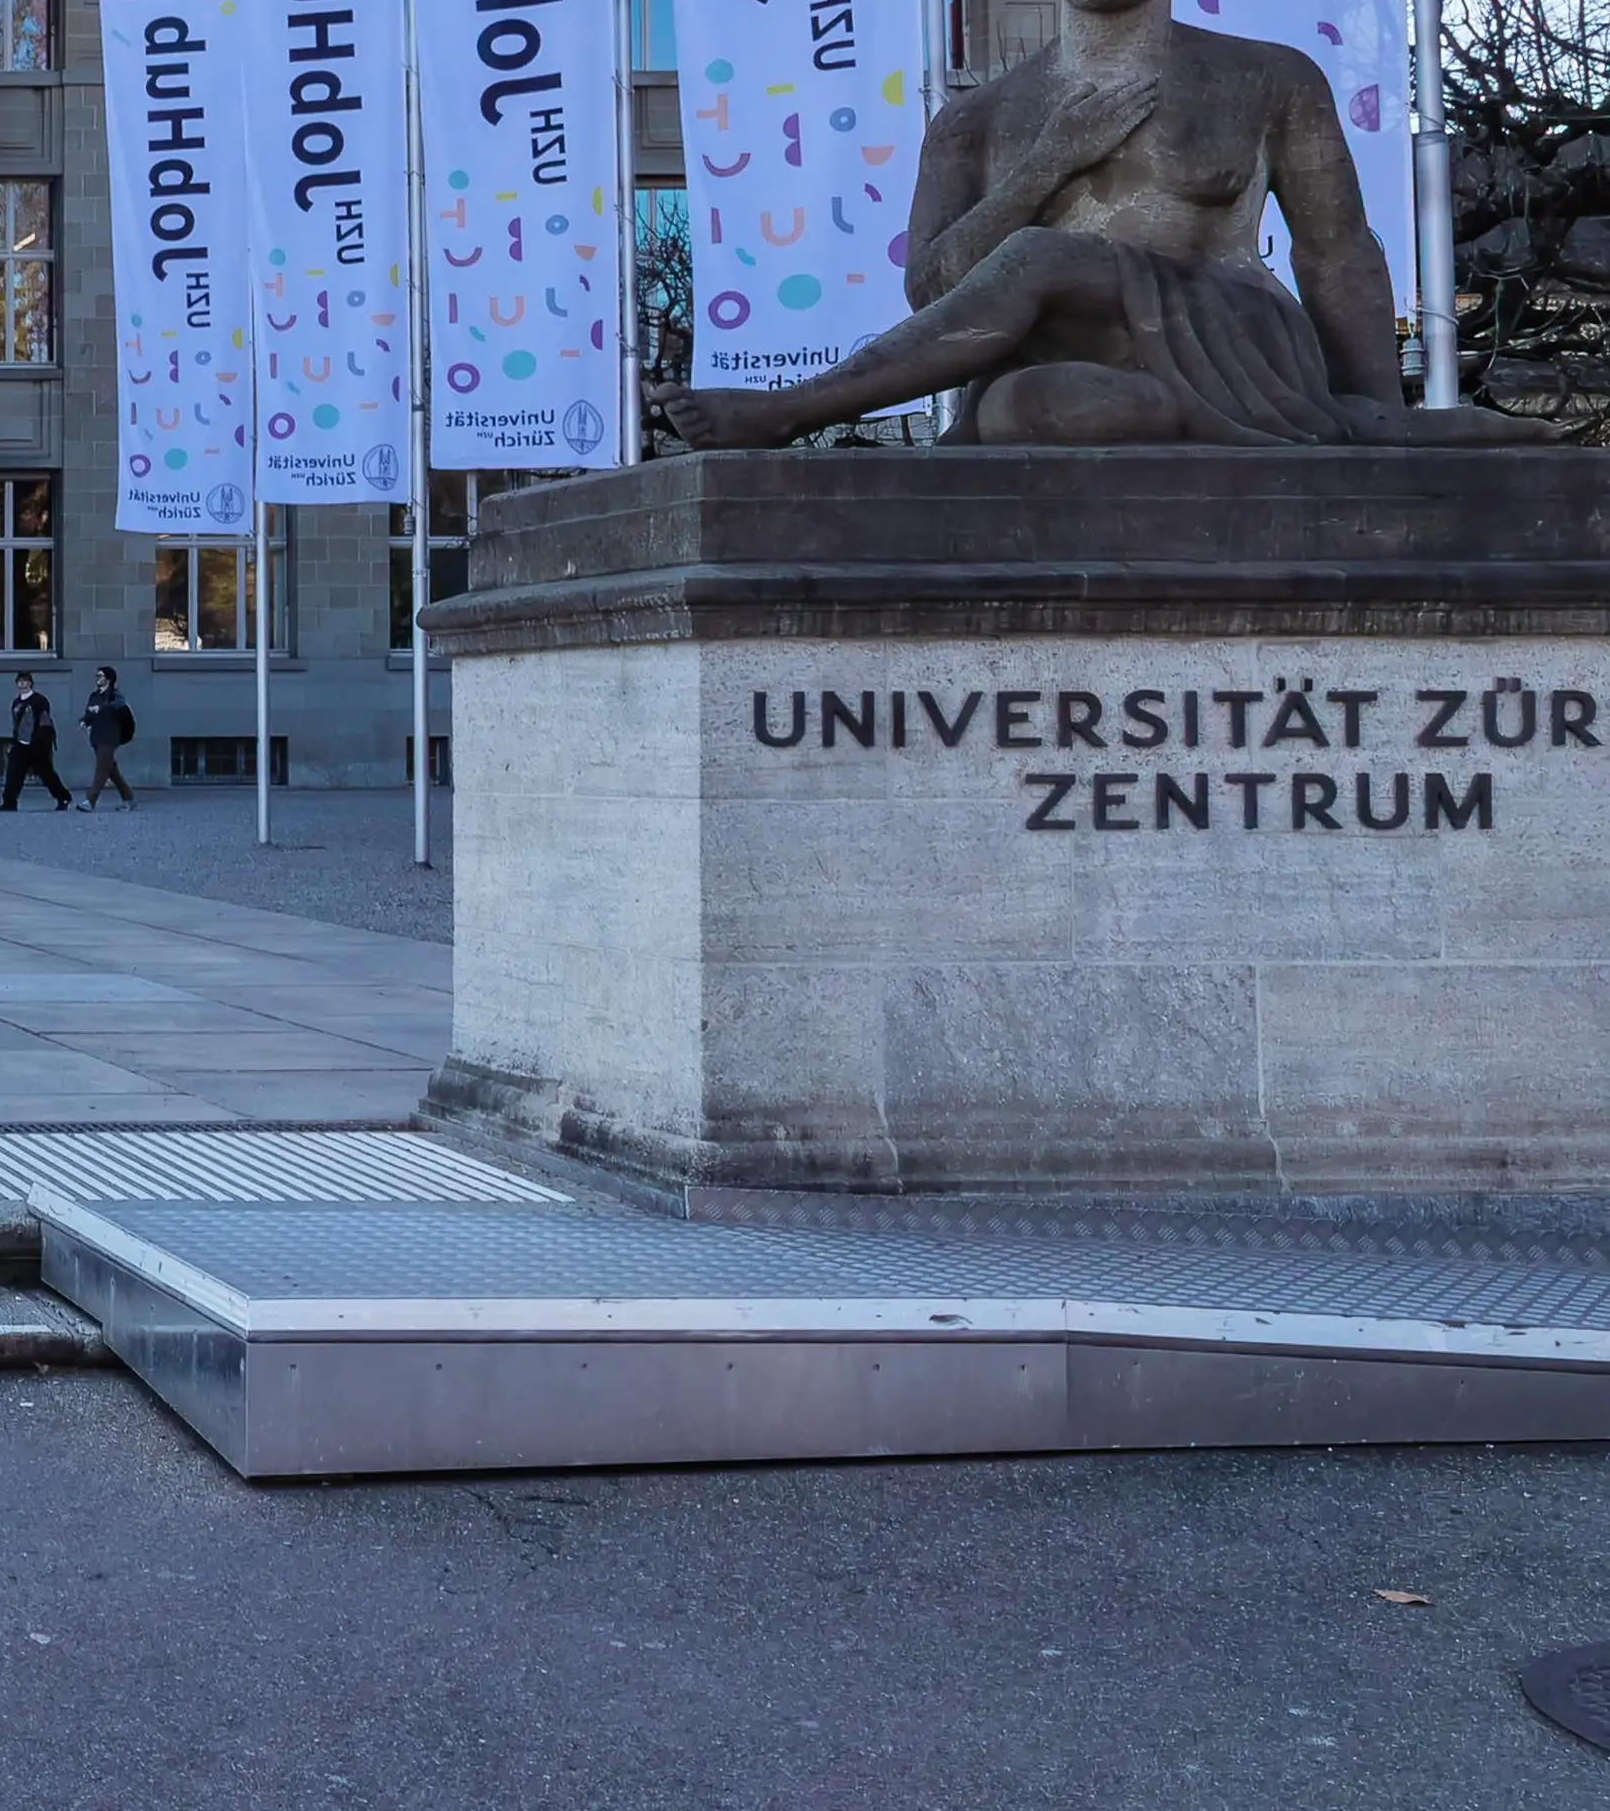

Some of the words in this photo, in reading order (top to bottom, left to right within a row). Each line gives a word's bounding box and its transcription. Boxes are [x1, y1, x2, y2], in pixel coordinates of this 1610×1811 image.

[752, 676, 1381, 751] UNIVERSITÄT
[1414, 676, 1605, 750] ZÜR
[1023, 772, 1494, 833] ZENTRUM
